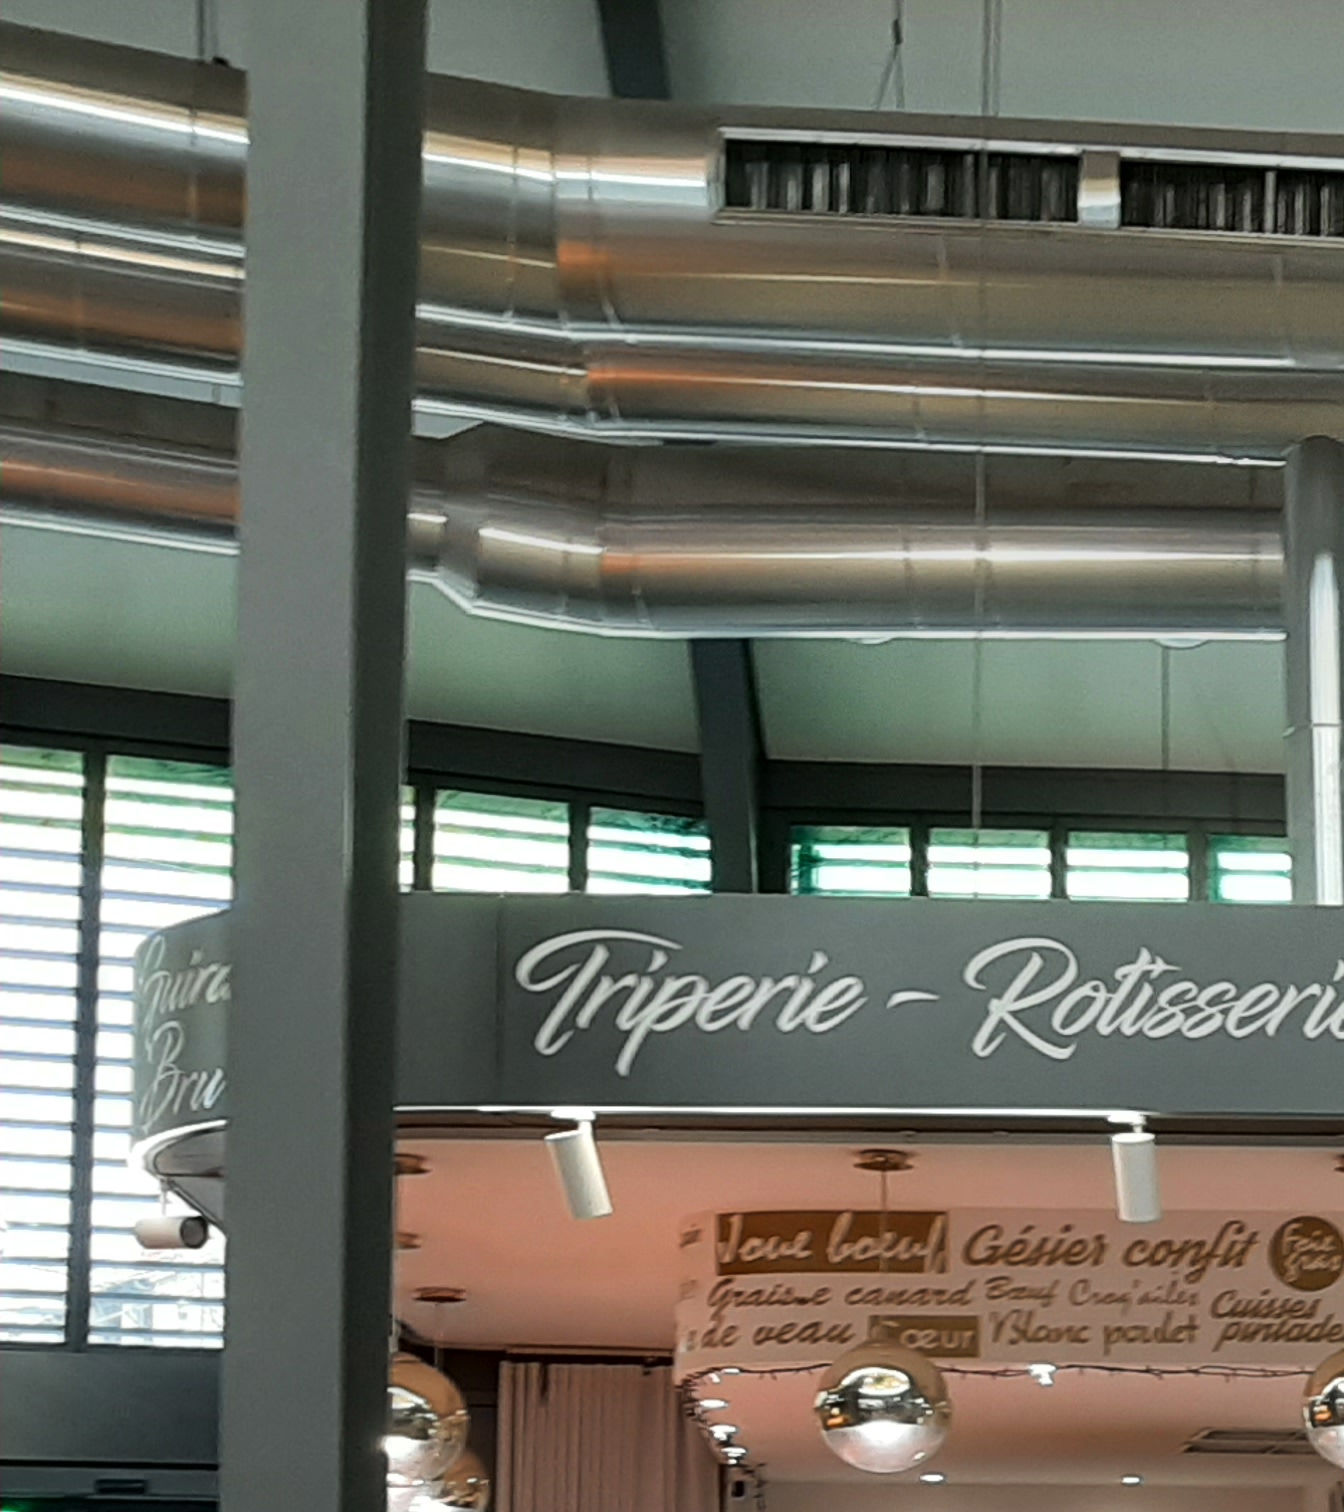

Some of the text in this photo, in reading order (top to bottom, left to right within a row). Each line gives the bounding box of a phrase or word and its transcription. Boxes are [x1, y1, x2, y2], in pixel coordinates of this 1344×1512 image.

[516, 928, 868, 1077] Triperie
[962, 1219, 1261, 1285] Gésier confit
[843, 1278, 977, 1307] canard
[1210, 1287, 1323, 1320] Cuisses
[753, 1320, 857, 1347] veau
[988, 1307, 1091, 1347] Blanc
[1103, 1310, 1201, 1356] poulet
